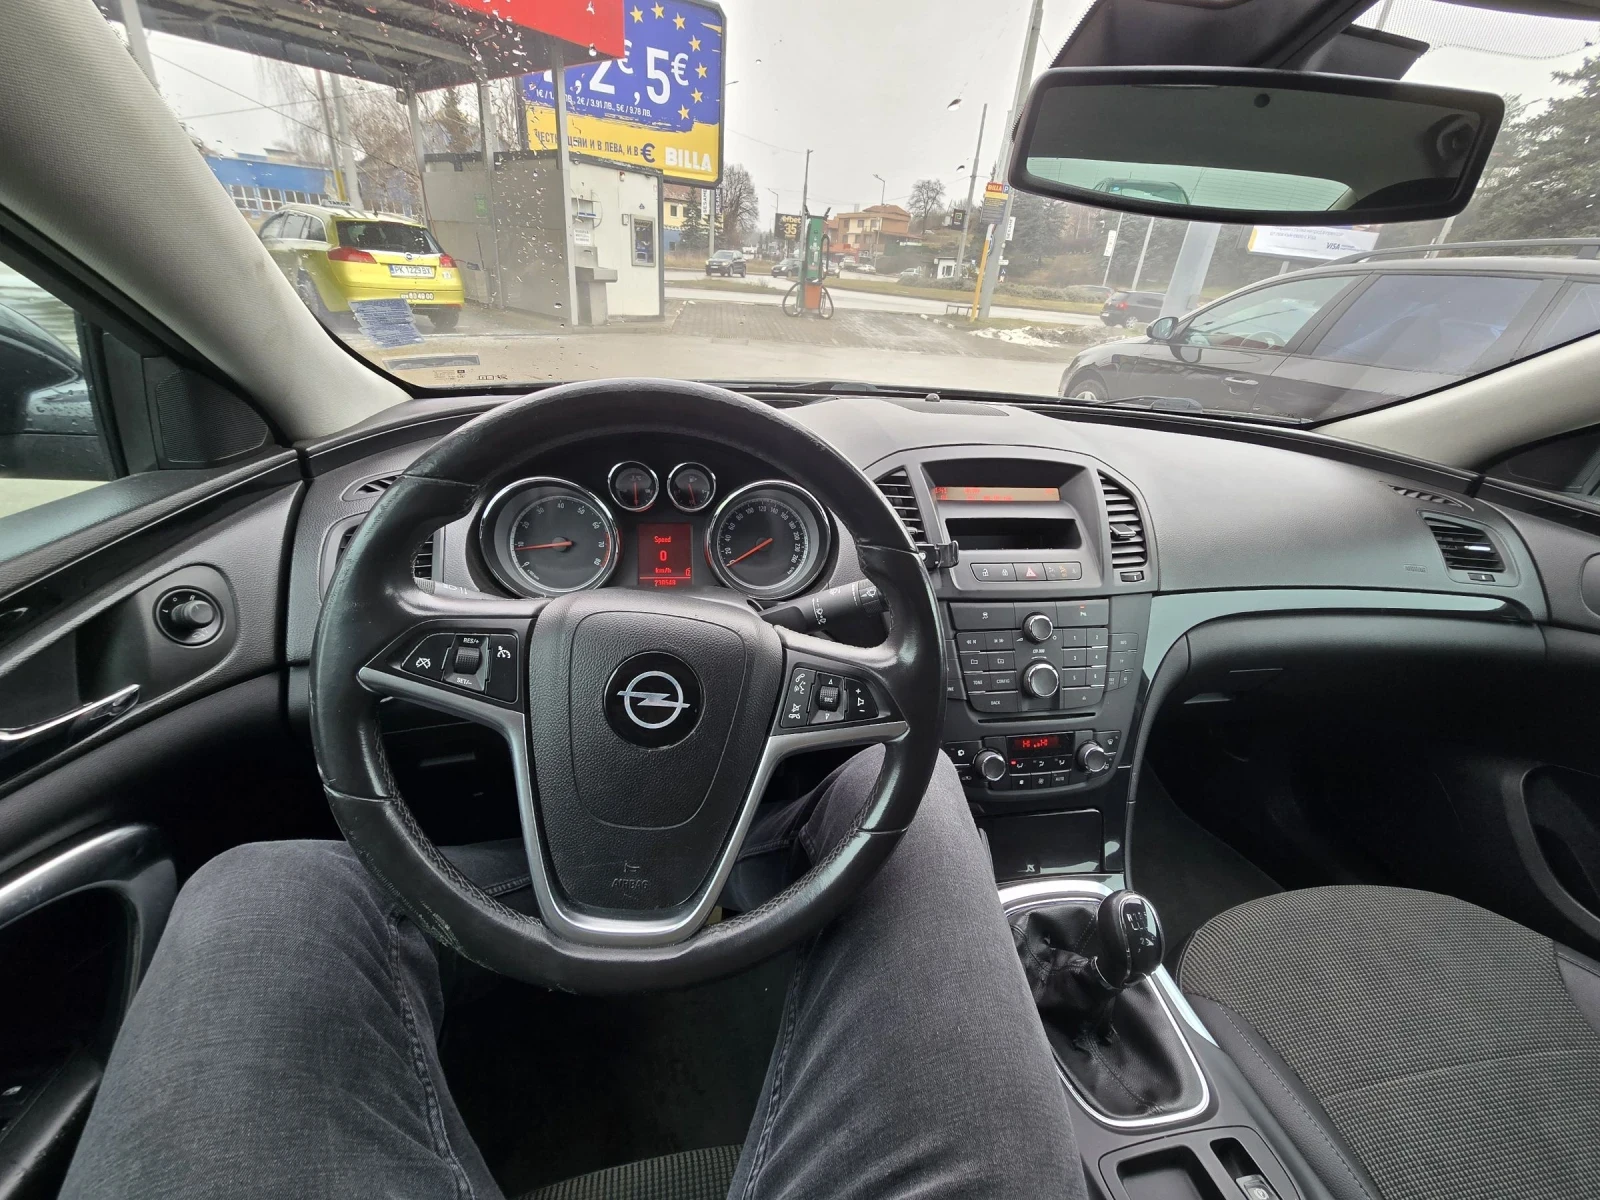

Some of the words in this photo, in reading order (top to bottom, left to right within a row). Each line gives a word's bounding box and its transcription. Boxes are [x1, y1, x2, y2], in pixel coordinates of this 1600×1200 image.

[646, 47, 689, 105] 5€
[576, 96, 586, 106] 2€
[590, 98, 602, 108] 3.91
[616, 103, 624, 112] 5€
[629, 106, 642, 115] 9.78
[642, 108, 652, 118] ЛВ.
[590, 138, 595, 149] И
[597, 140, 602, 150] В
[605, 142, 625, 156] ЛЕВА,
[627, 145, 632, 155] И
[634, 146, 639, 156] В
[640, 142, 656, 163] €
[664, 146, 712, 172] BILLA
[784, 223, 797, 235] 35
[1326, 242, 1341, 250] VISA
[736, 513, 744, 521] 80
[780, 512, 789, 520] 160
[788, 521, 796, 529] 180
[654, 536, 672, 544] Speed
[724, 547, 732, 555] 20
[660, 550, 667, 561] 0
[594, 558, 601, 566] 80
[1126, 913, 1133, 922] R
